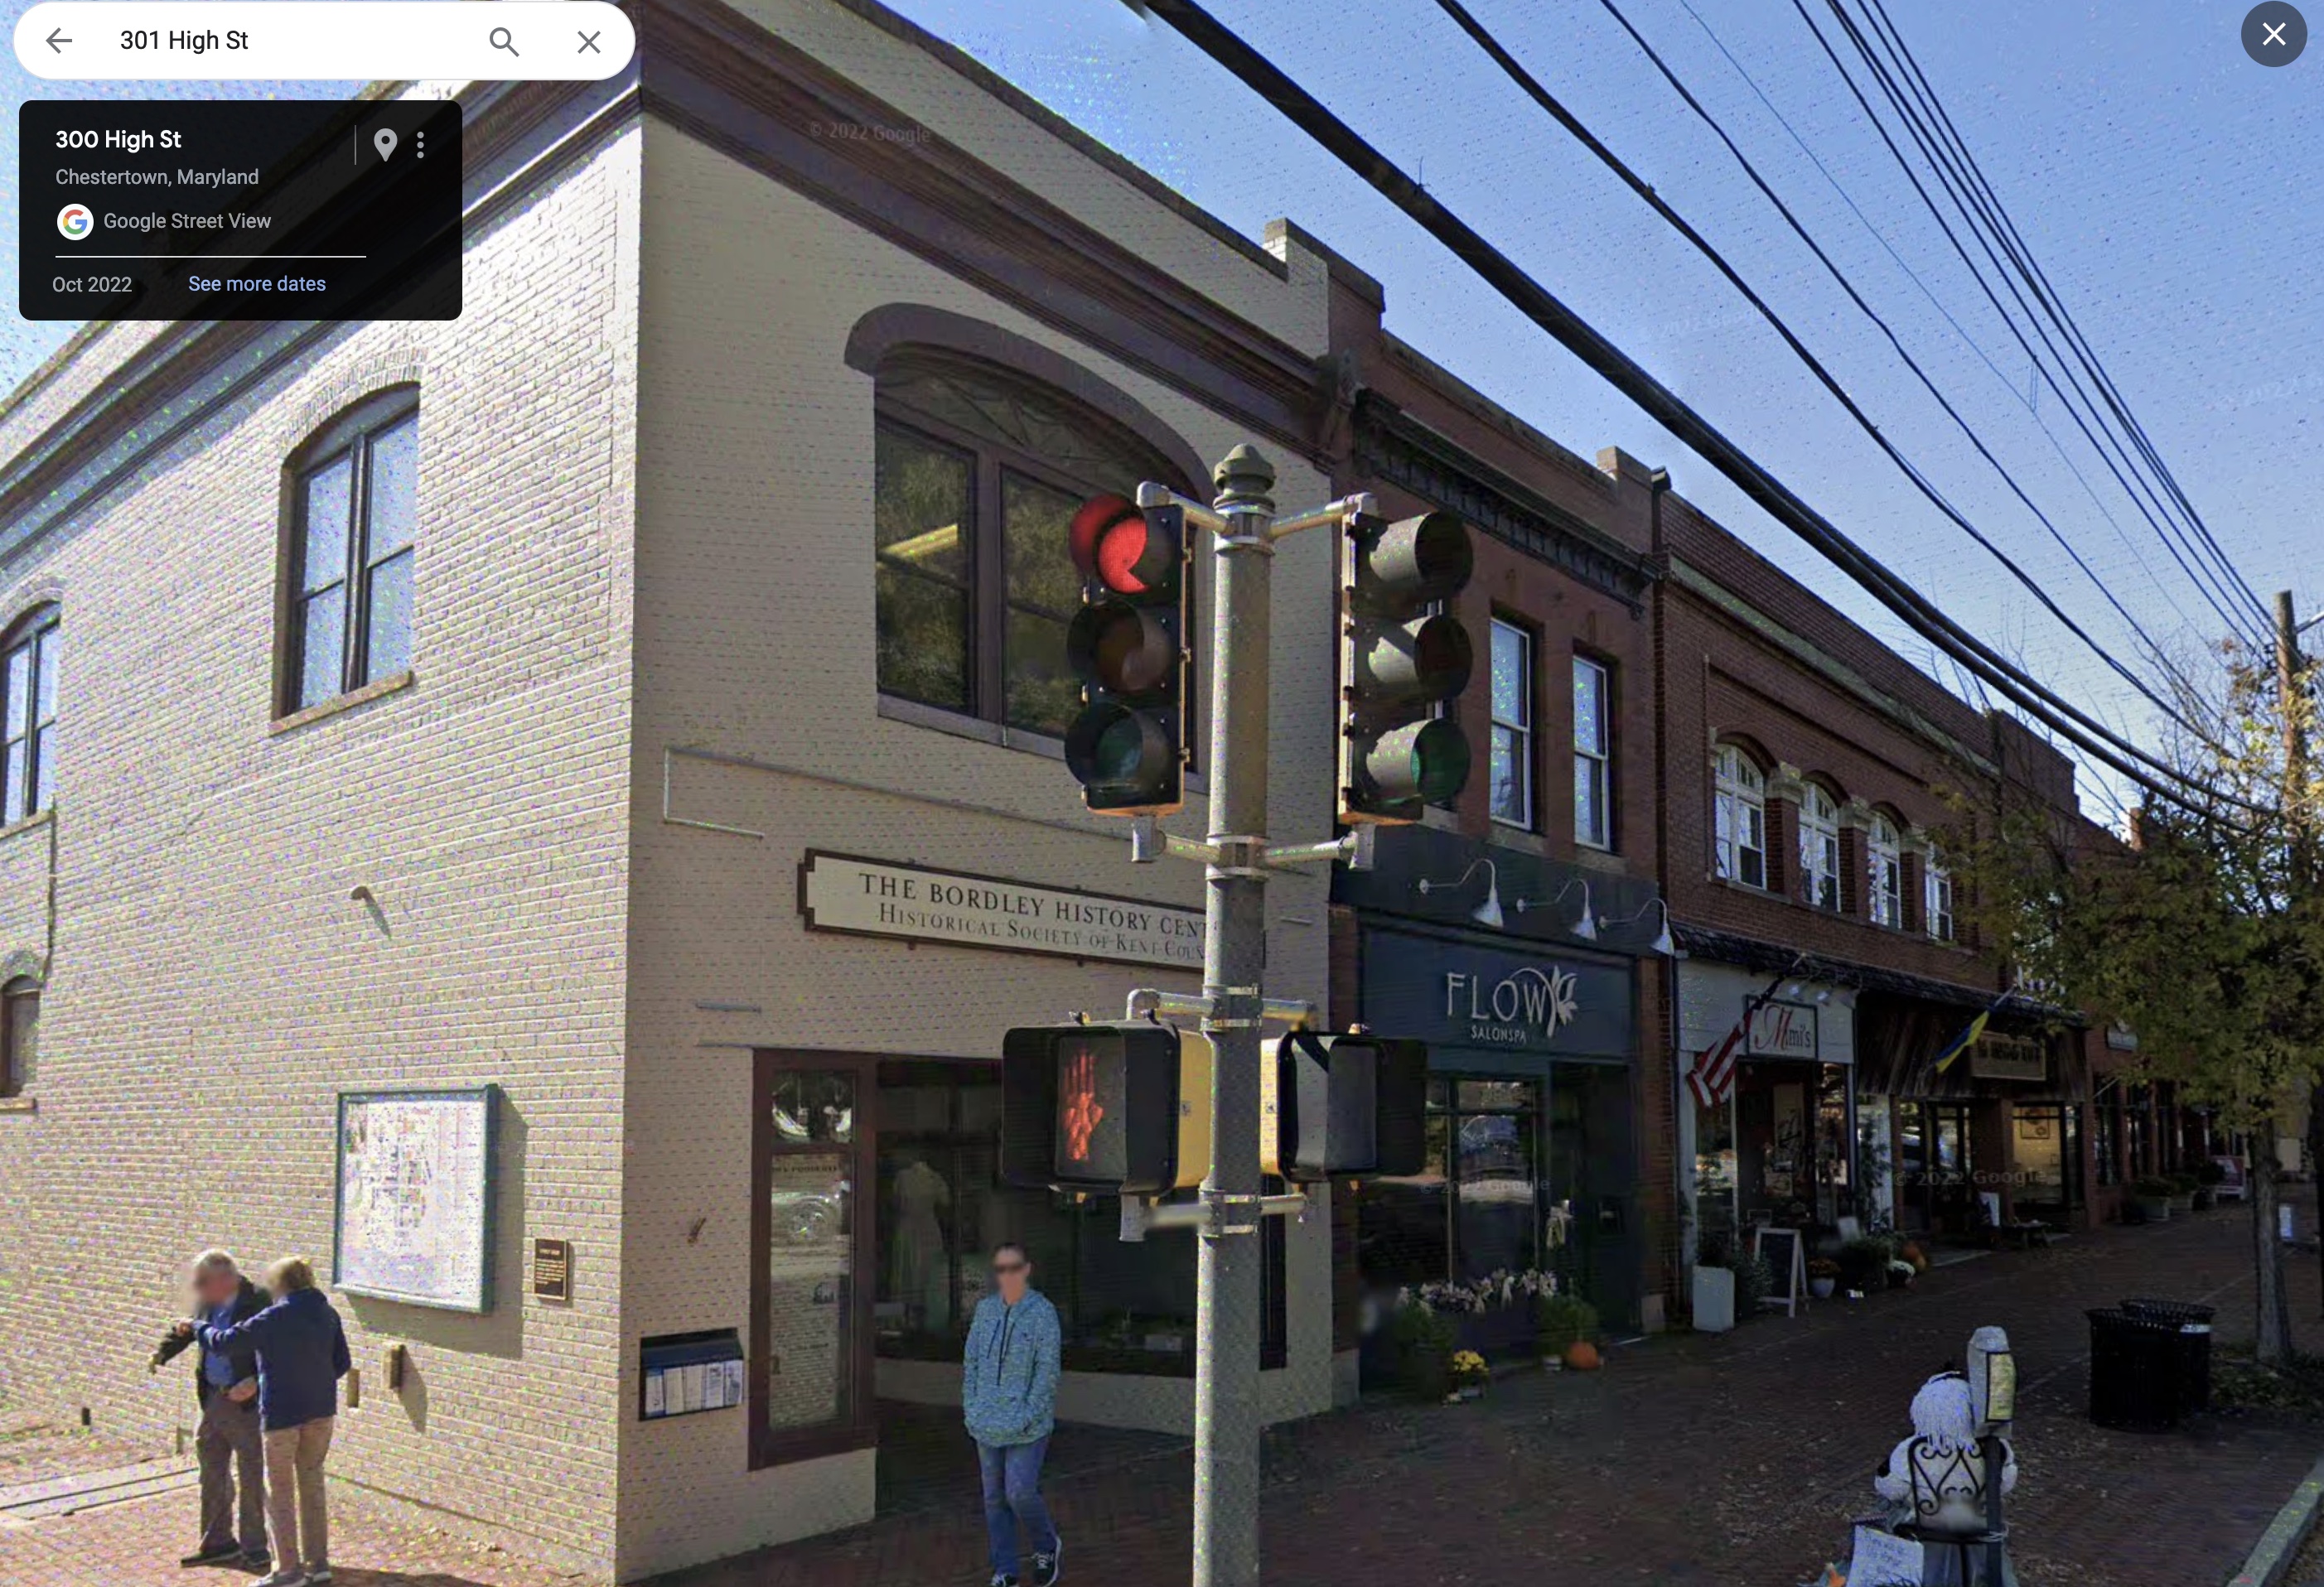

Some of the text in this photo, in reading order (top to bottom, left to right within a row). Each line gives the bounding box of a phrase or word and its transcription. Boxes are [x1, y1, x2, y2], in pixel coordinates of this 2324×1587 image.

[858, 872, 1207, 939] THE BORDLEY HISTORY CENT
[879, 902, 1000, 938] HISTORICAL
[1007, 919, 1083, 946] SOCIETY
[1165, 940, 1205, 960] COUN
[1446, 972, 1547, 1025] FLOW
